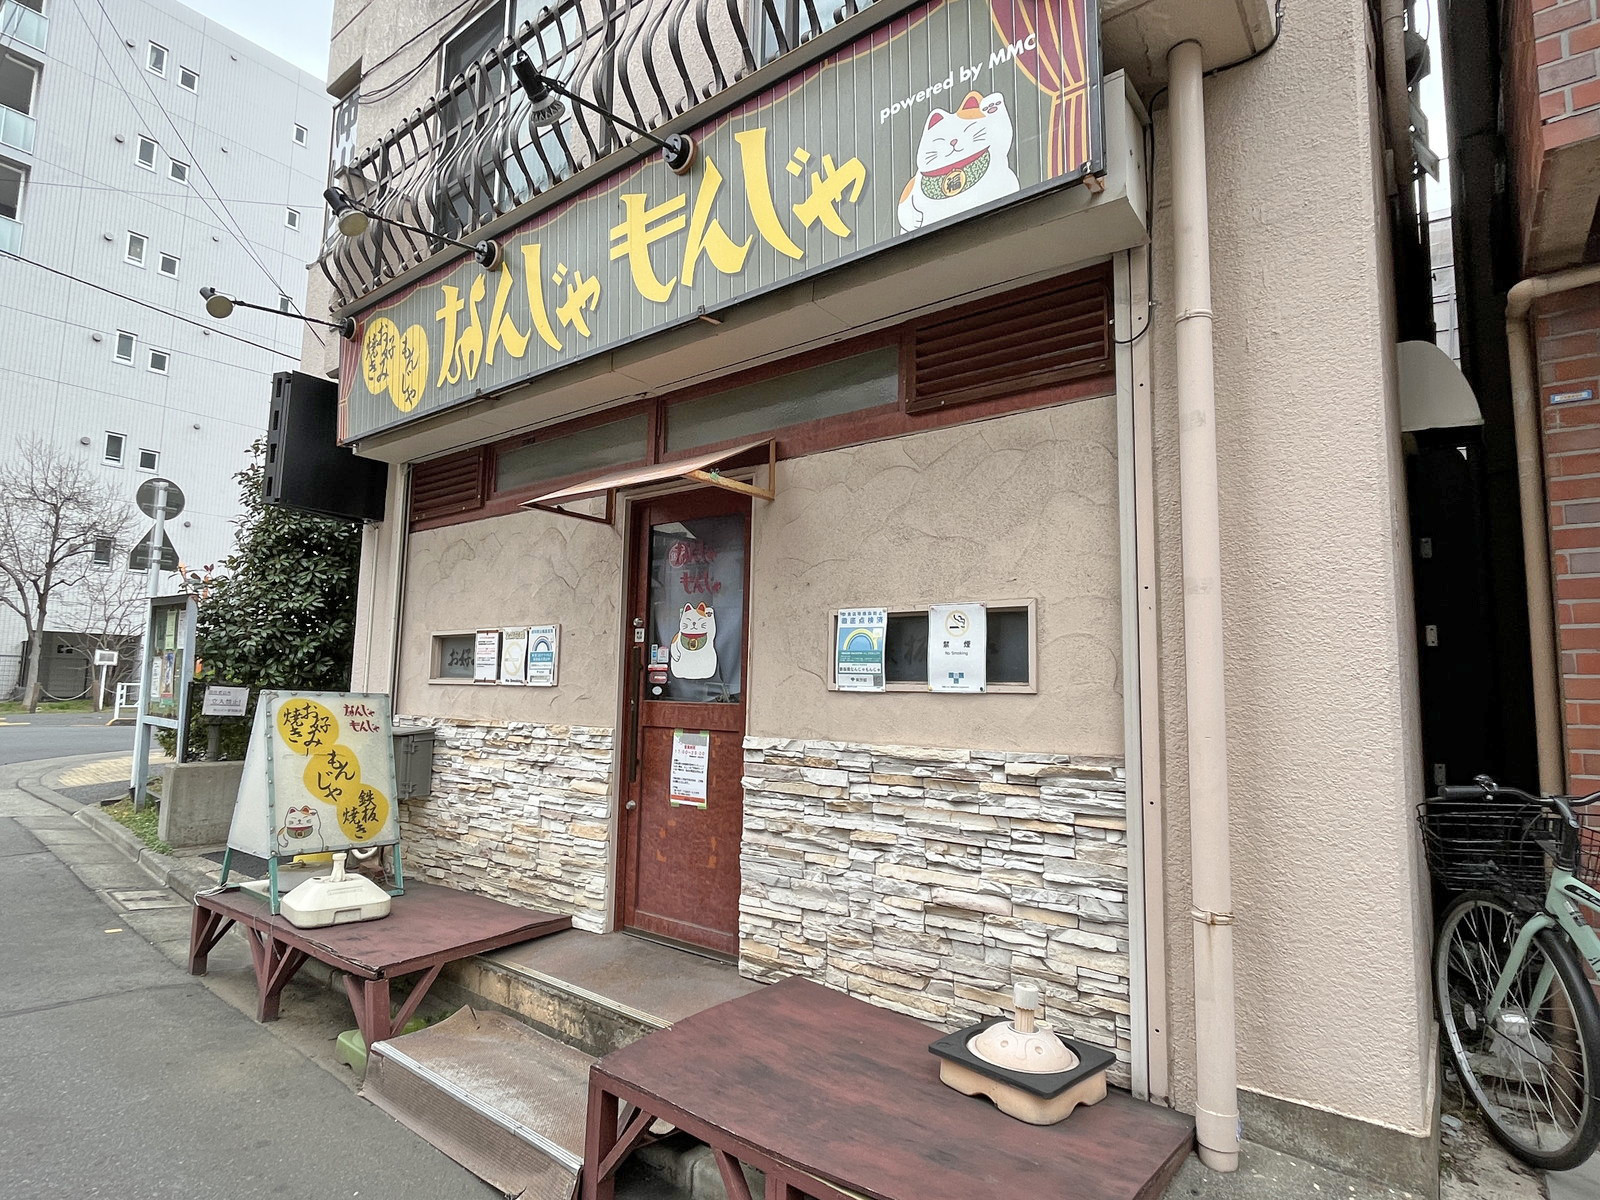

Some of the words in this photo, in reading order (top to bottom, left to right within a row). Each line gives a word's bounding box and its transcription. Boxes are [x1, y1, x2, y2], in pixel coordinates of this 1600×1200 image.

[880, 71, 954, 124] powered
[959, 62, 983, 82] by
[988, 33, 1037, 69] MMC
[436, 244, 601, 387] なんじゃ
[610, 127, 867, 303] もんじゃ
[377, 322, 396, 383] お好み
[401, 335, 420, 406] もんじゃ
[283, 707, 303, 743] 焼き
[343, 704, 375, 717] なんじゃ
[349, 720, 380, 733] もんじゃ
